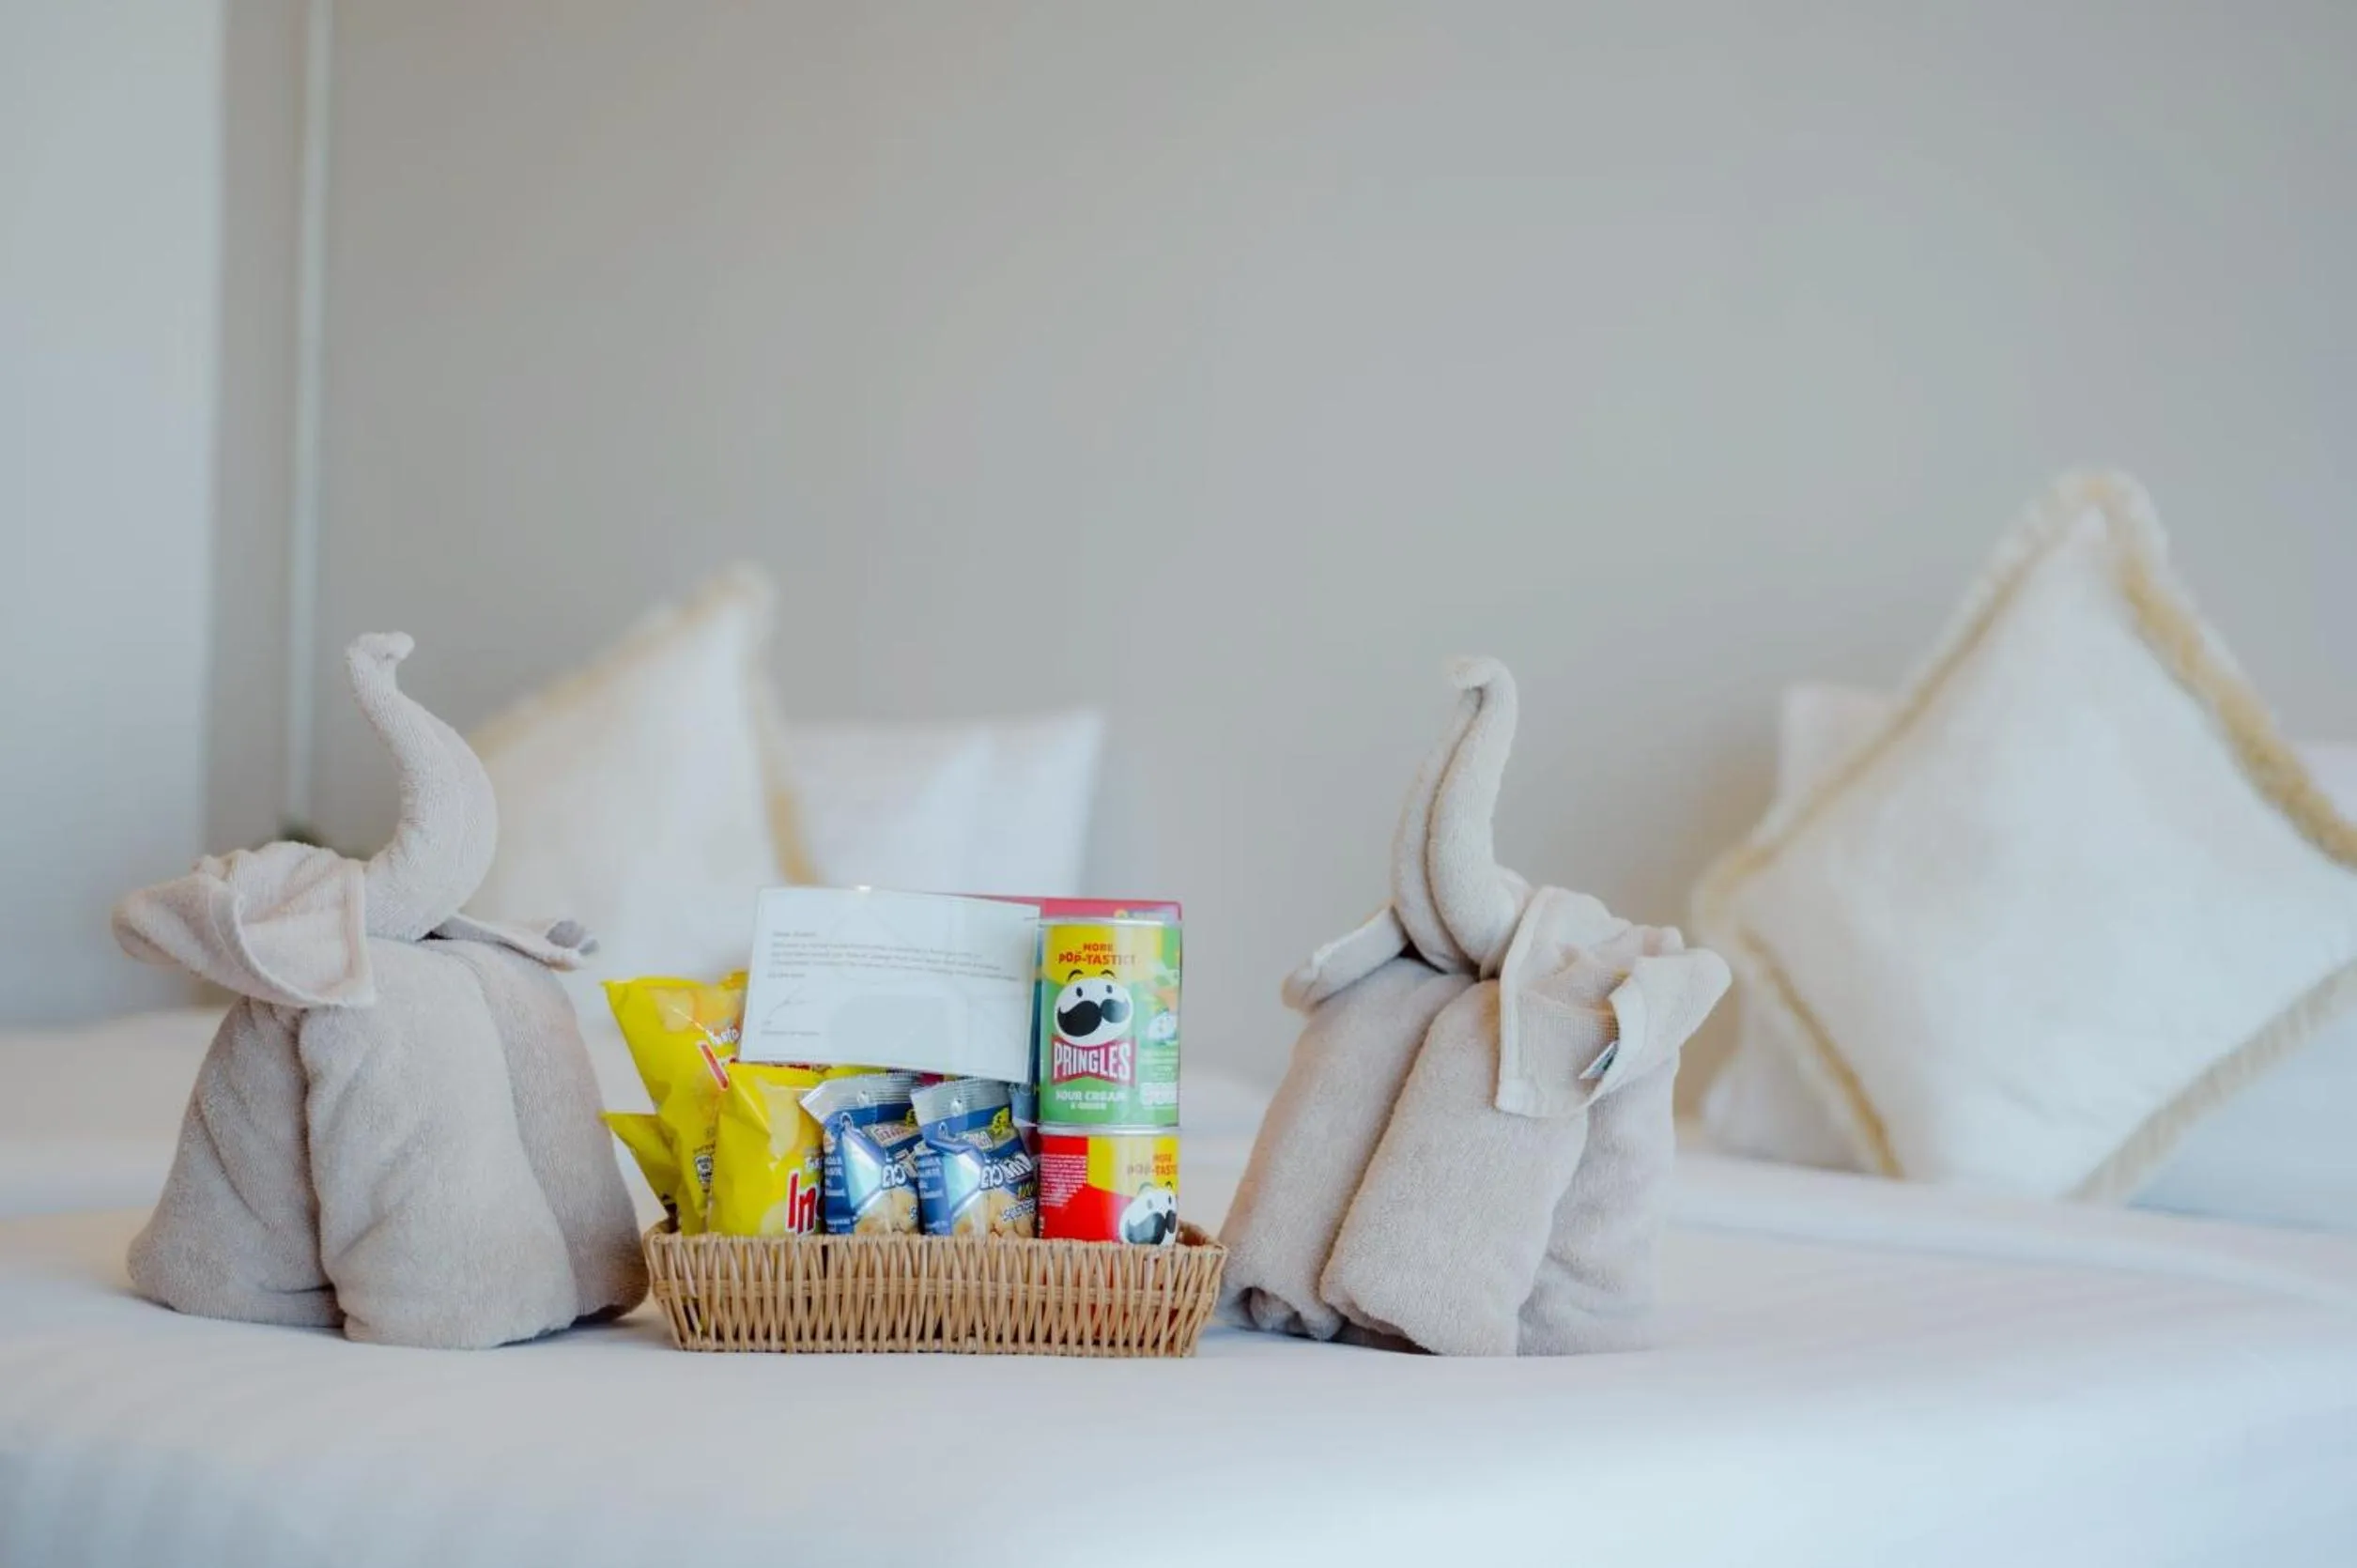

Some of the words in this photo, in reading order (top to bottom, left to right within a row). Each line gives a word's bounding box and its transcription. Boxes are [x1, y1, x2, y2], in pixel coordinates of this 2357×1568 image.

[1083, 943, 1114, 952] MORE
[1054, 1041, 1132, 1081] PRINGLES
[1055, 1090, 1083, 1101] SOUR
[1086, 1091, 1128, 1102] CREAM
[785, 1169, 820, 1235] In
